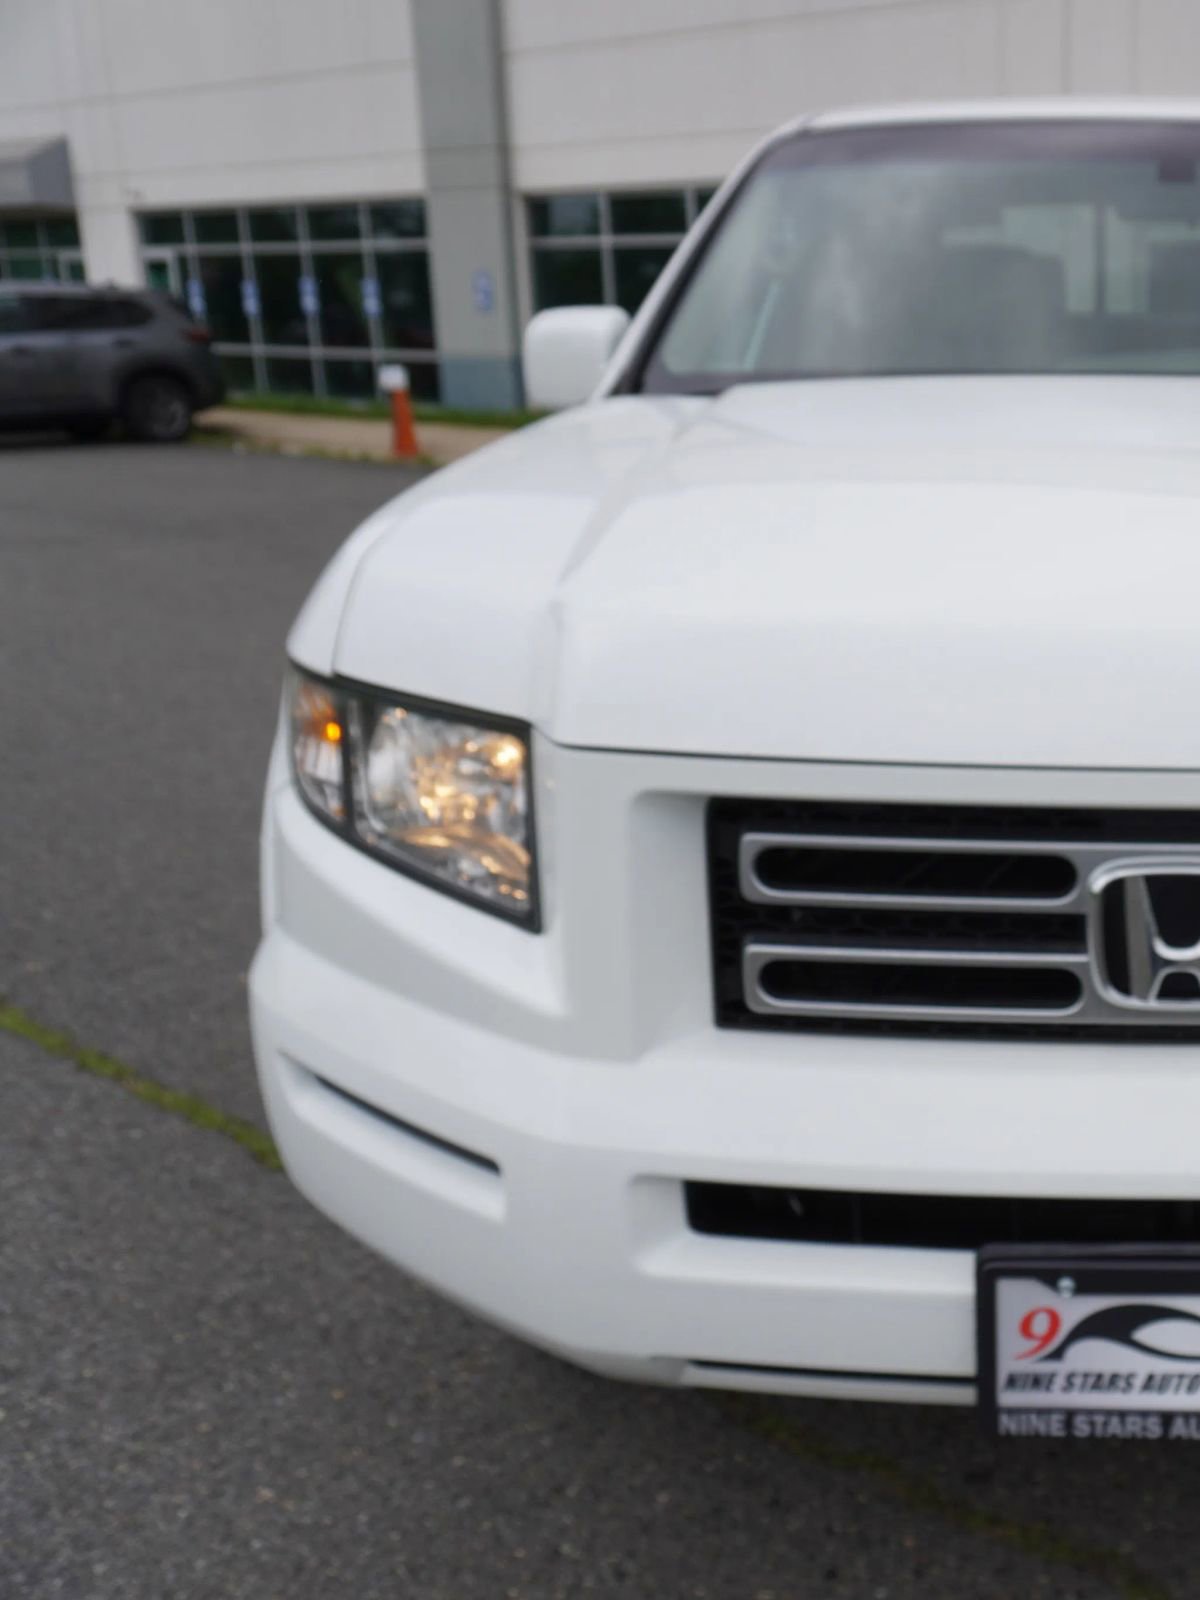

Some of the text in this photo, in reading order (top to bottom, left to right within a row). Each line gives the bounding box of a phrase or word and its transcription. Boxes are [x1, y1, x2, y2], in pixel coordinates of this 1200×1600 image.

[1013, 1306, 1062, 1360] 9
[1003, 1370, 1055, 1392] NINE
[1062, 1371, 1136, 1393] STARS
[1141, 1372, 1200, 1394] AUTO
[999, 1414, 1067, 1437] NINE
[1072, 1415, 1164, 1439] STARS
